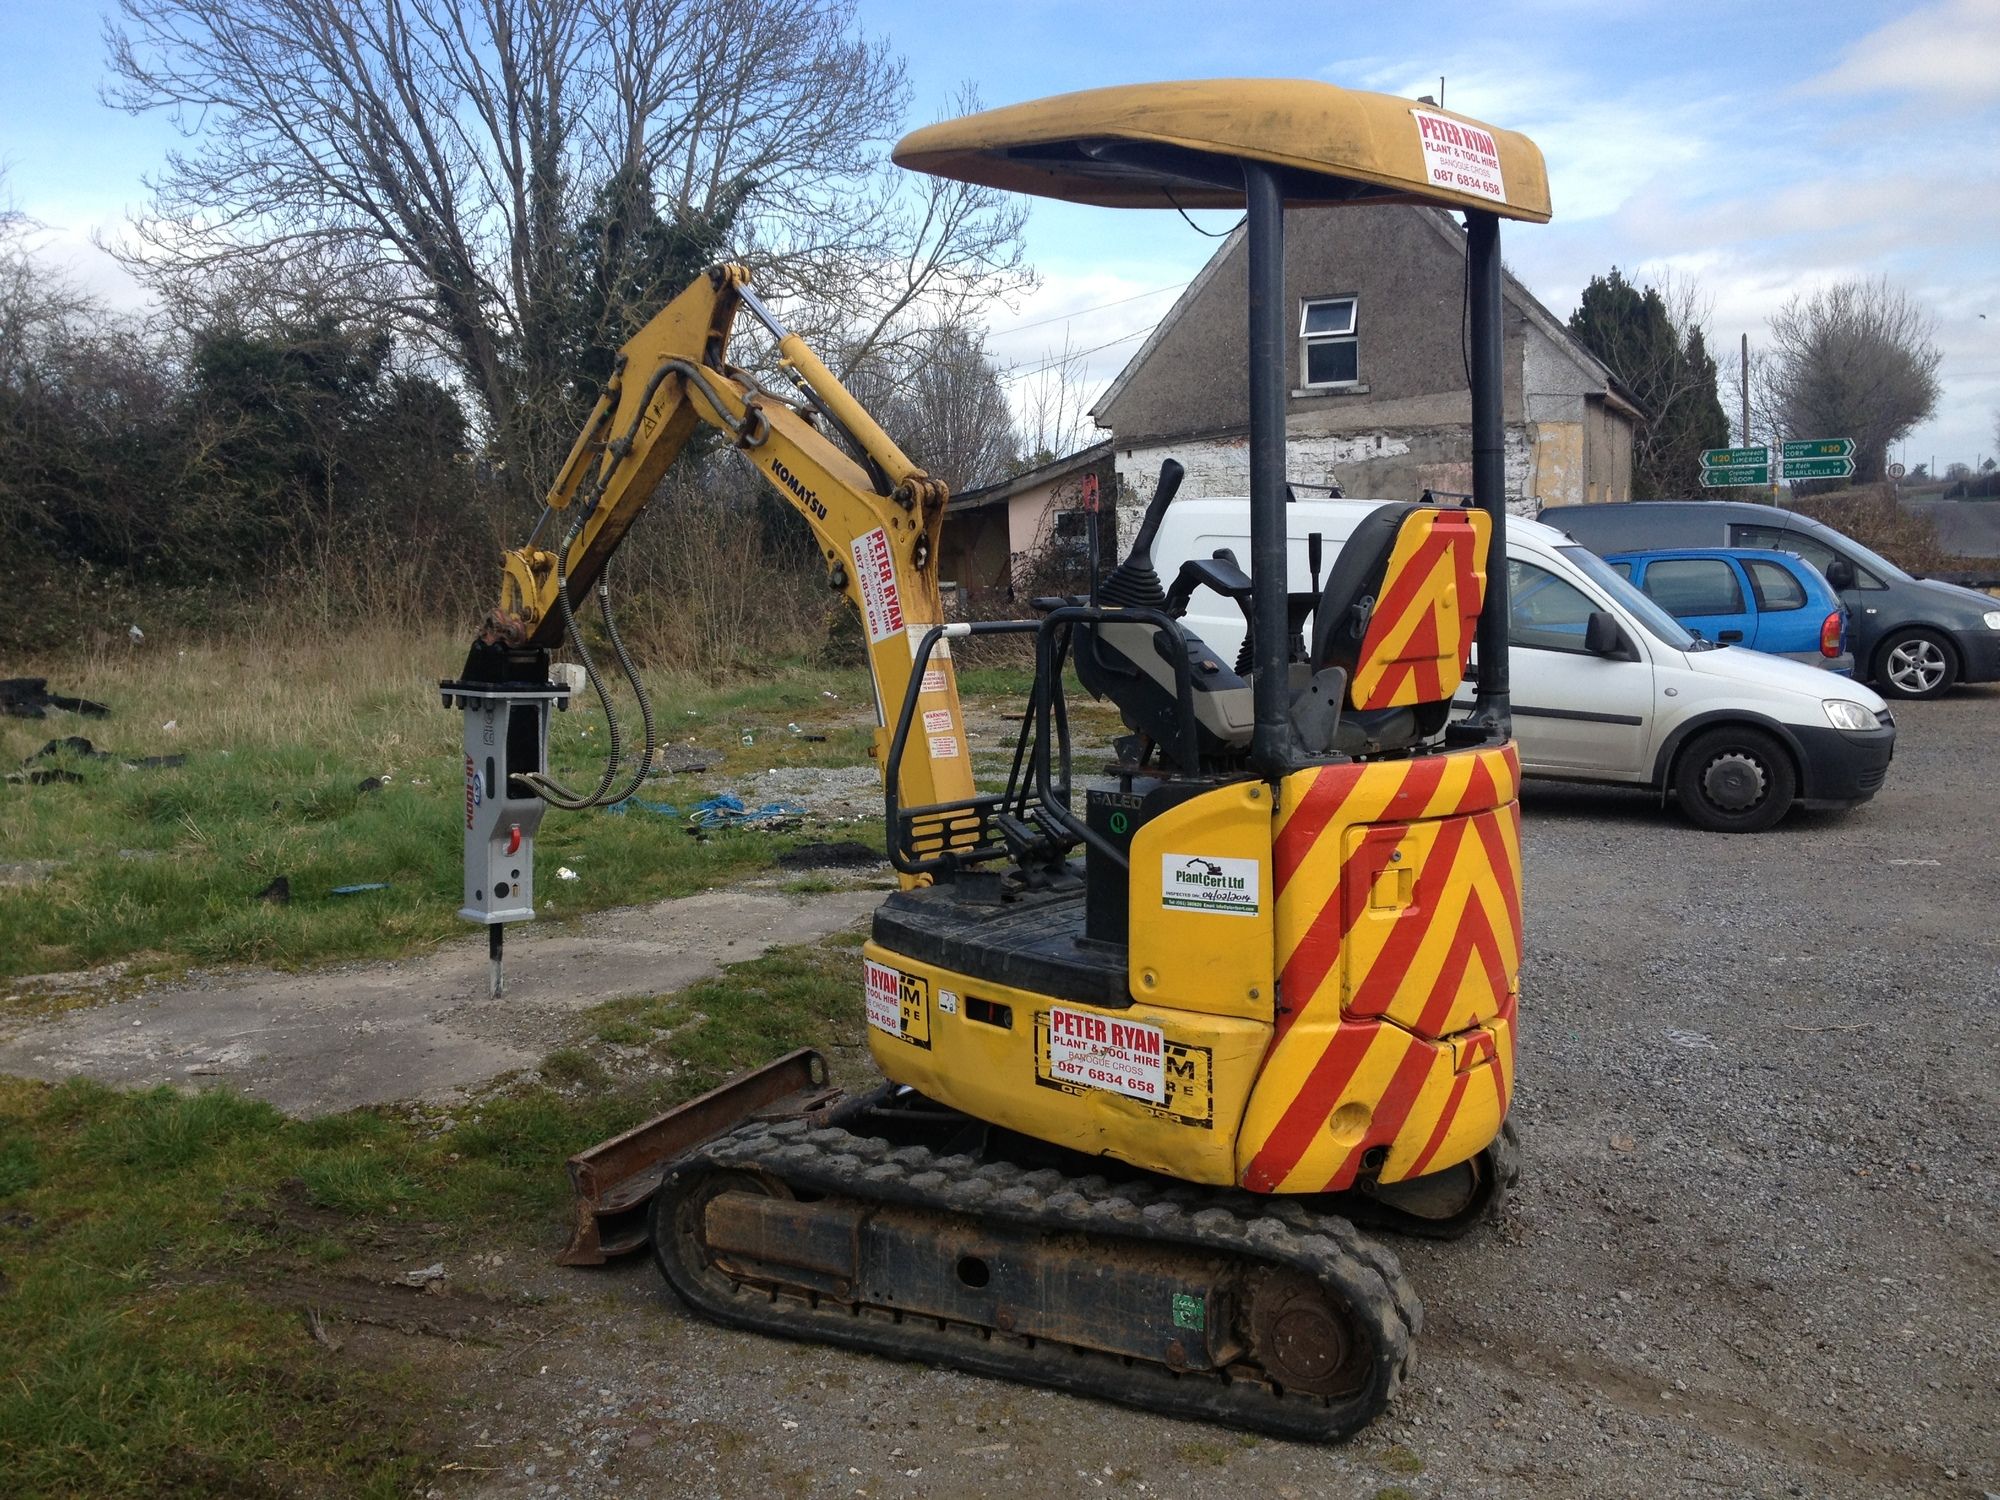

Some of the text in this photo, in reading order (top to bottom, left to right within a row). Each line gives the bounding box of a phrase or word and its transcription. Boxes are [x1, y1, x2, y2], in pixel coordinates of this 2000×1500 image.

[1417, 115, 1496, 157] PETER RYAN
[1425, 141, 1498, 170] PLANT & TOOL HIRE
[1433, 168, 1500, 195] 087 6834 658
[1711, 454, 1730, 463] N20
[1820, 444, 1841, 453] N20
[1785, 468, 1831, 476] CHARLEVILLE
[771, 458, 828, 521] KOMATSU
[854, 545, 878, 636] 087 6834 658
[865, 535, 892, 634] PLANT & TOOL HIRE
[871, 529, 904, 632] PETER RYAN
[1228, 876, 1244, 889] Ltd
[871, 967, 898, 996] RYAN
[867, 988, 882, 1001] TOOL
[883, 994, 898, 1007] HIRE
[881, 1015, 897, 1029] 658
[1053, 1010, 1160, 1056] PETER RYAN
[1053, 1035, 1088, 1051] PLANT
[1091, 1043, 1099, 1054] &
[1101, 1046, 1130, 1062] TOOL
[1133, 1054, 1160, 1069] HIRE
[1068, 1051, 1144, 1076] BANOGUE CROSS
[1058, 1061, 1155, 1094] 087 6834 658
